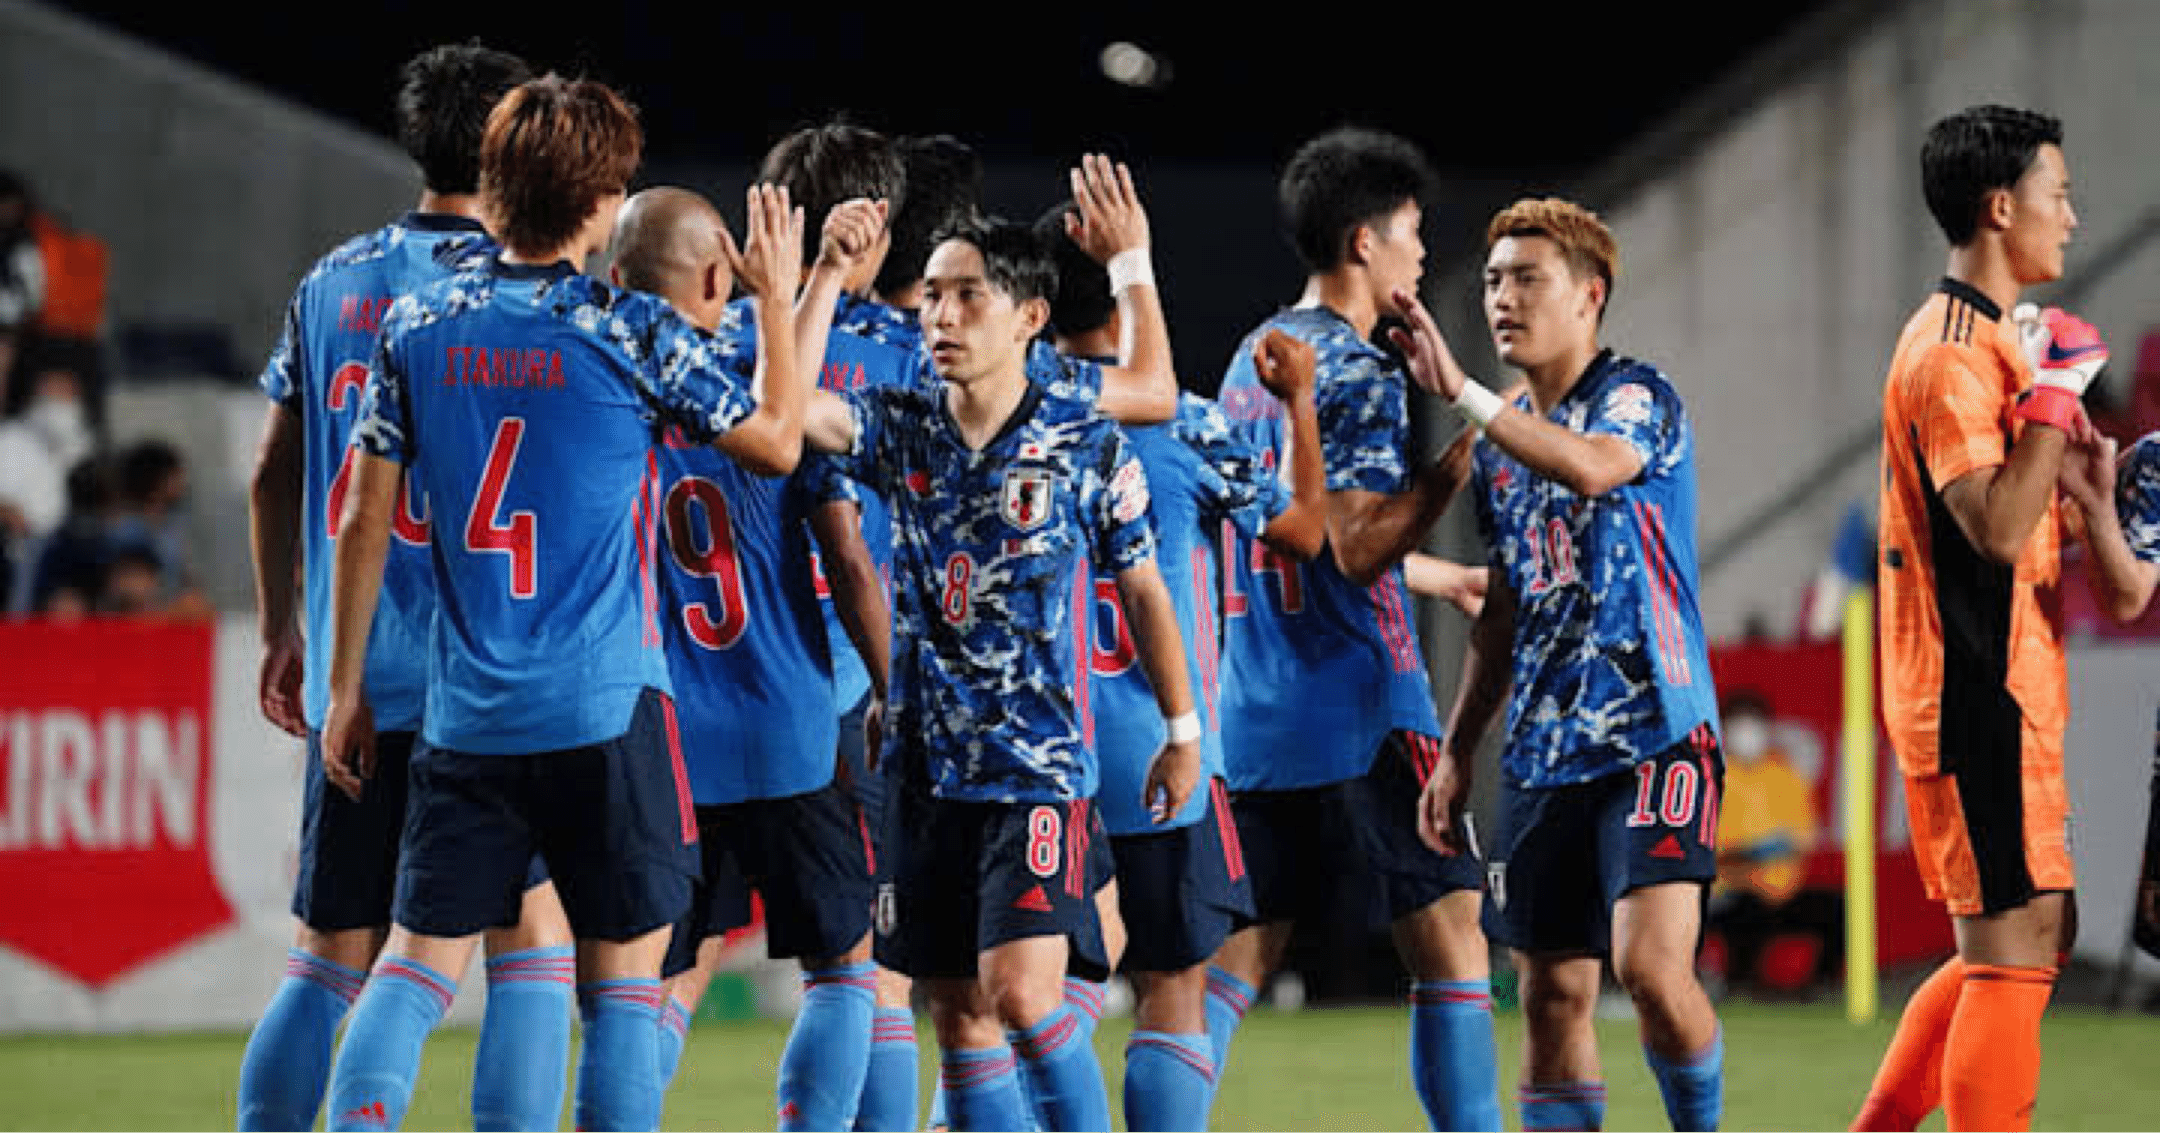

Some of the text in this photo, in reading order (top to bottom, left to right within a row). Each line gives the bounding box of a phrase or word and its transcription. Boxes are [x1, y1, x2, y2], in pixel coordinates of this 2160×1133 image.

[444, 347, 565, 388] ITAKURA
[465, 416, 538, 600] 4
[665, 475, 748, 650] 9
[943, 550, 972, 625] 8
[1524, 516, 1577, 594] 10
[0, 712, 197, 848] IRIN
[1625, 760, 1698, 827] 10
[1026, 804, 1061, 878] 8
